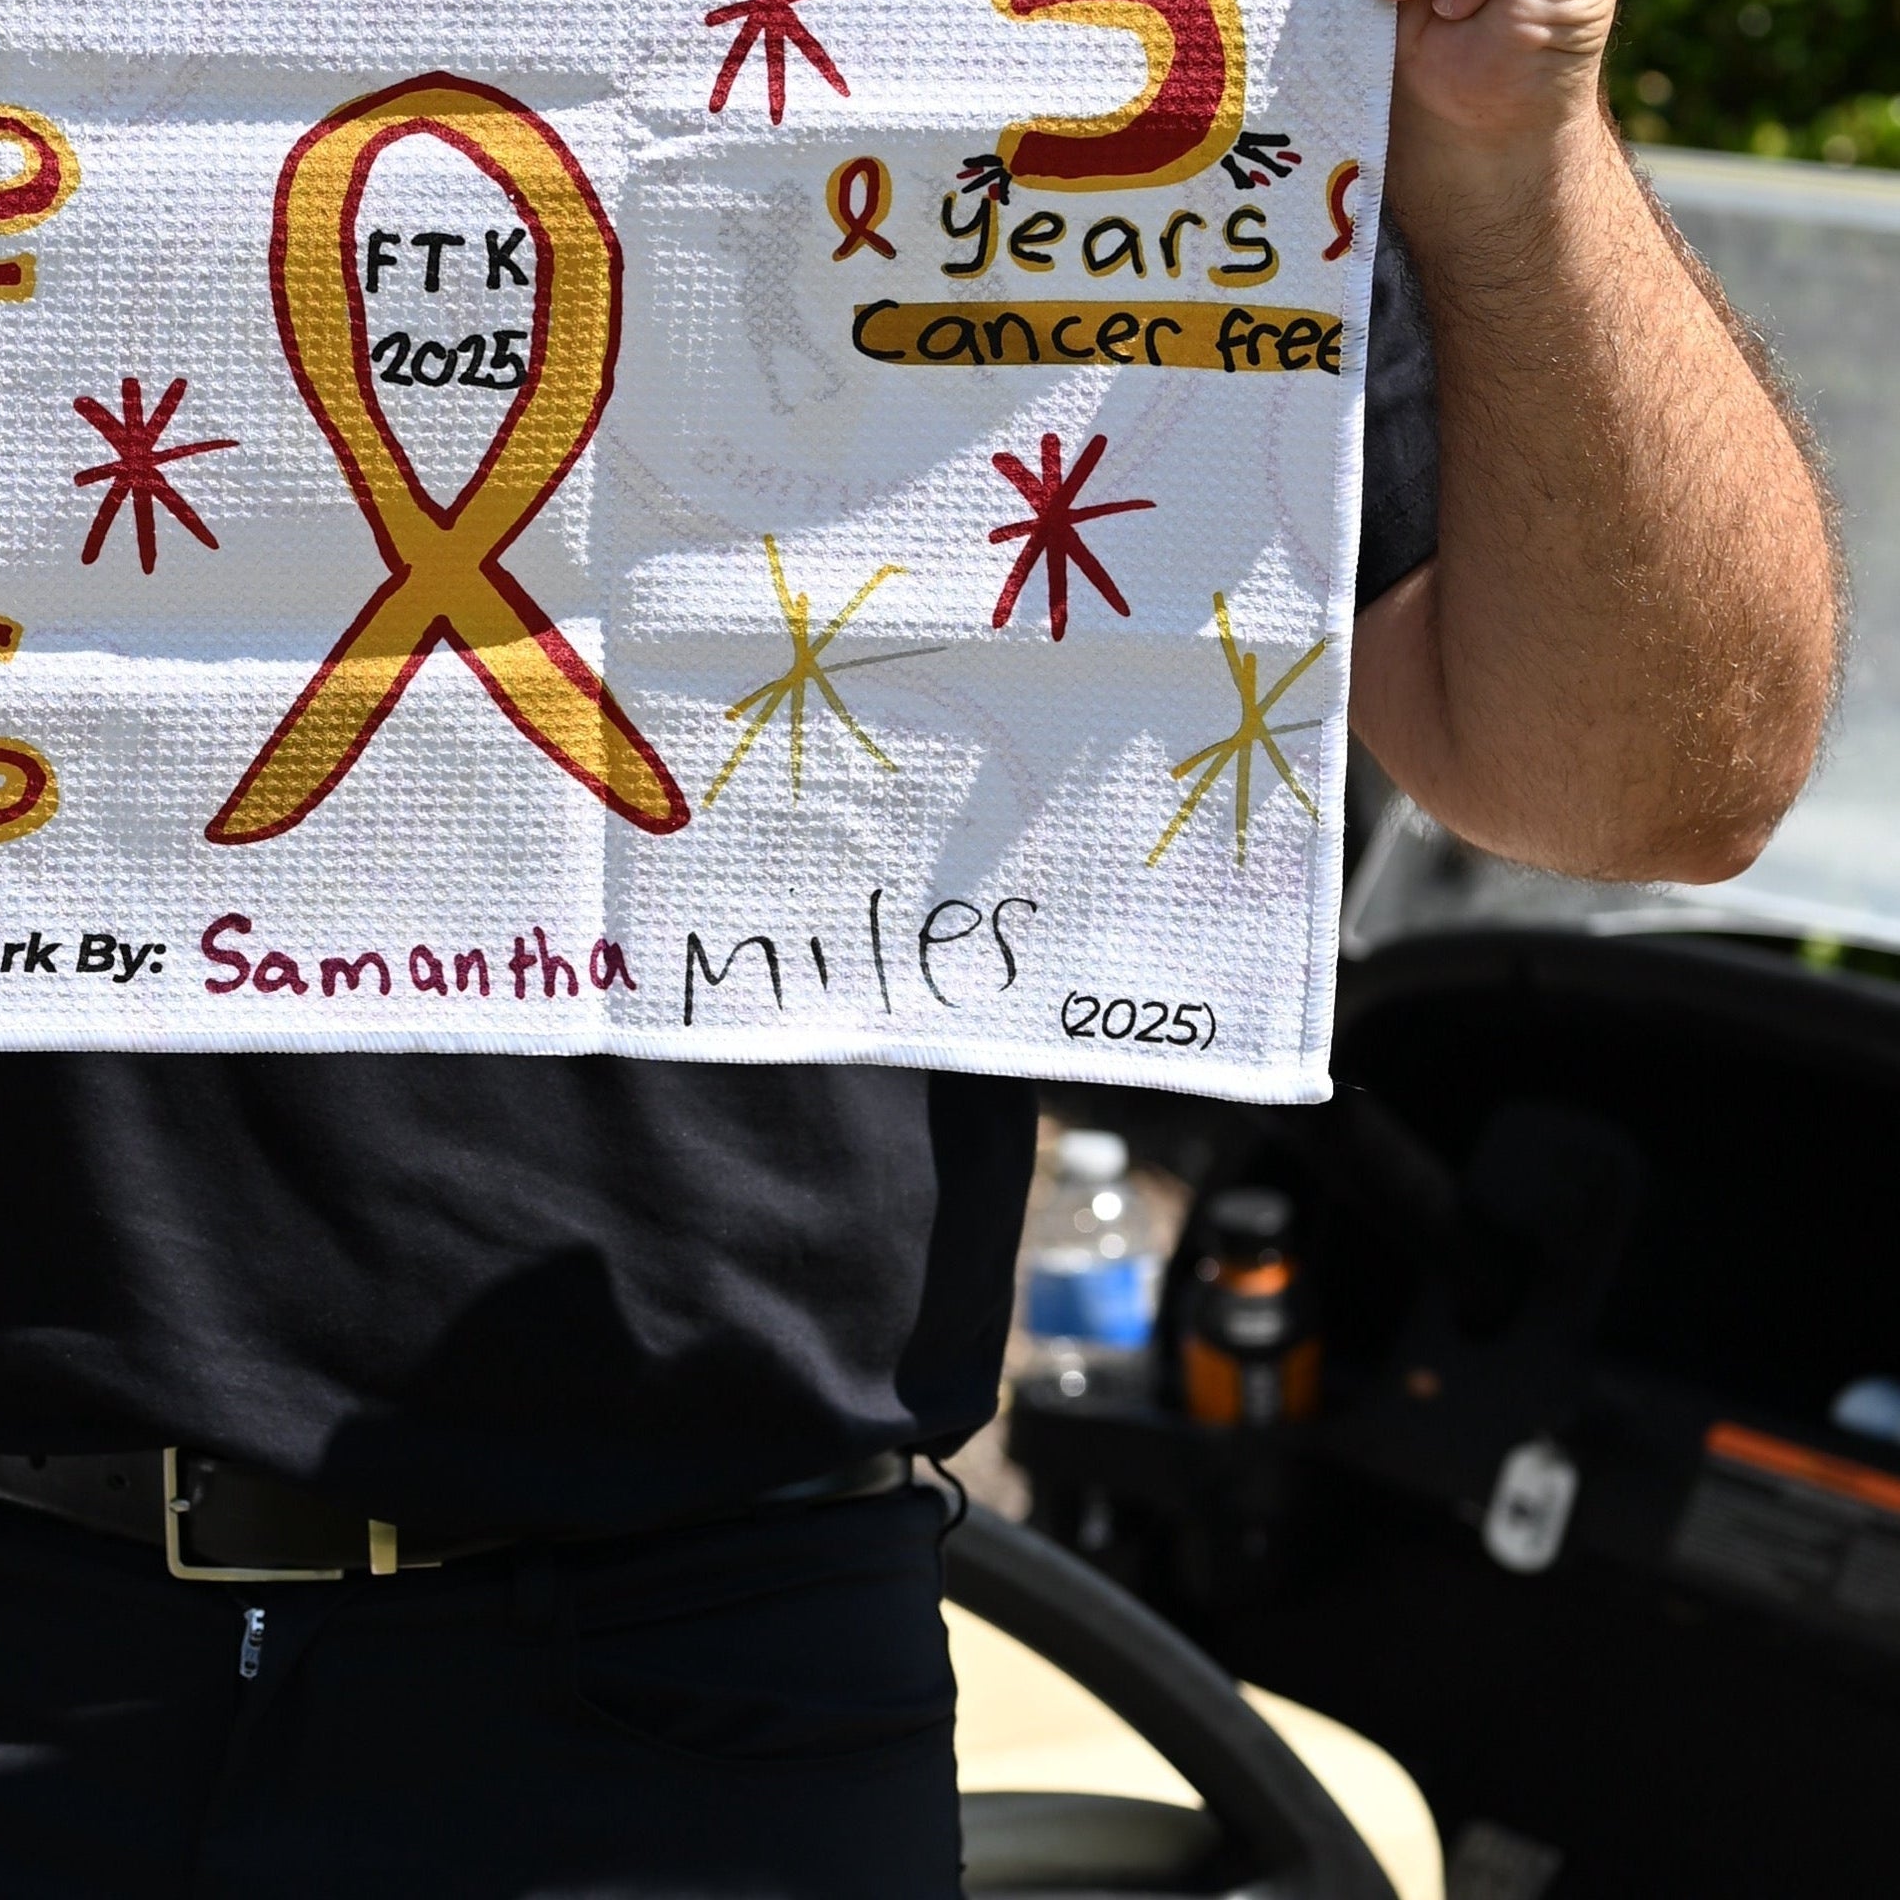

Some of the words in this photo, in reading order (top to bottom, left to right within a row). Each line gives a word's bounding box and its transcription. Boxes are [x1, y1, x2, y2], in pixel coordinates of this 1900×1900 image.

[365, 226, 531, 293] FTK
[939, 190, 1280, 289] years
[371, 329, 531, 389] 2025
[76, 932, 168, 984] By:
[201, 910, 639, 1001] Samantha
[683, 886, 1038, 1027] Miles
[1060, 989, 1218, 1052] (2025)
